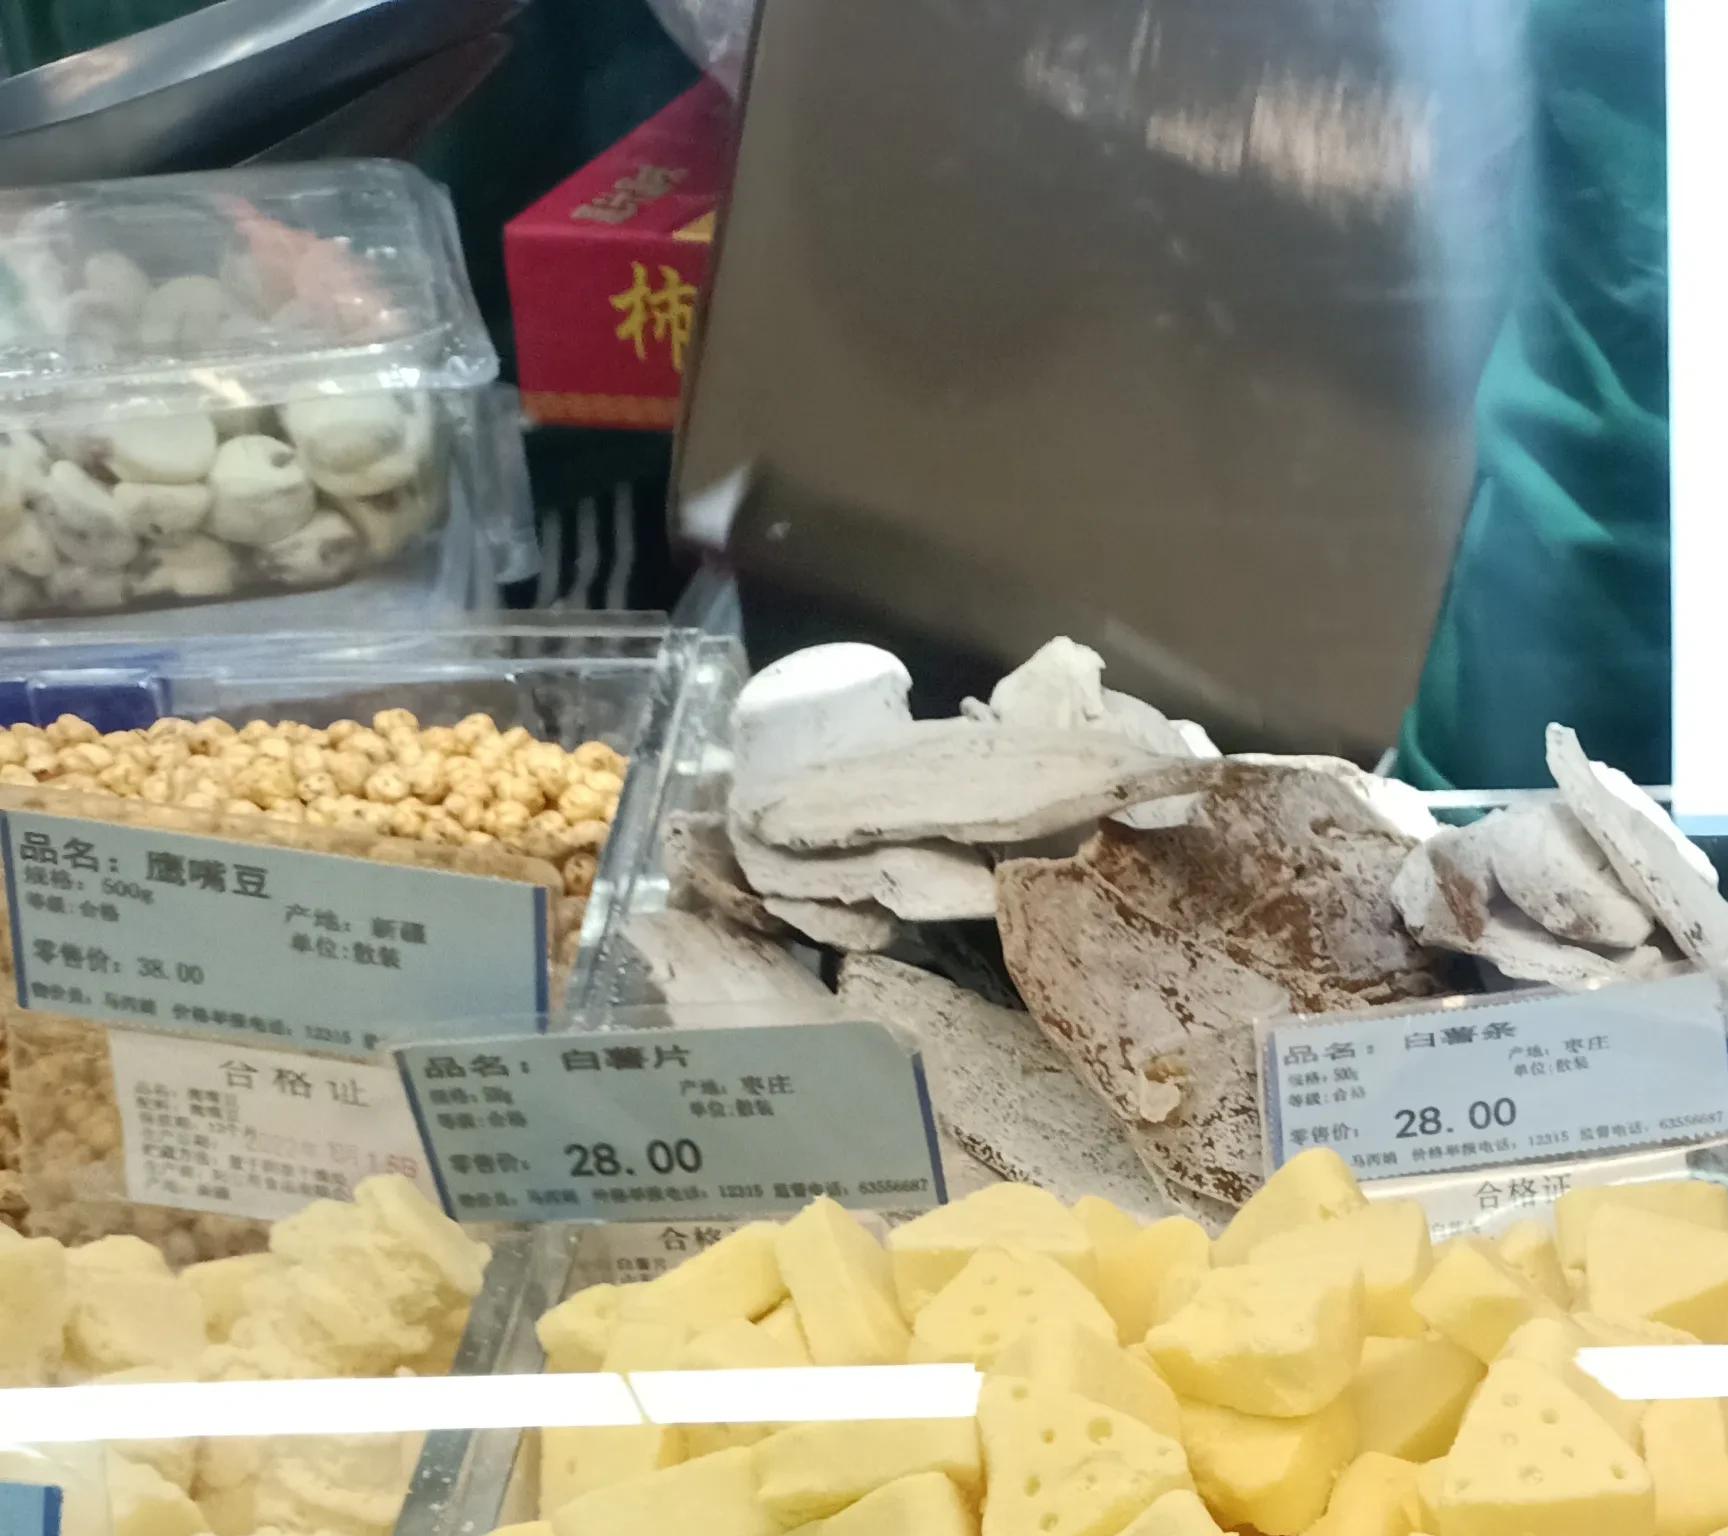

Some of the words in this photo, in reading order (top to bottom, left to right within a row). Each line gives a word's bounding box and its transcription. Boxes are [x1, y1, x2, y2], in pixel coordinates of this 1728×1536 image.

[218, 1059, 372, 1108] 合格证
[1394, 1097, 1517, 1140] 28.00
[564, 1138, 703, 1178] 28.00
